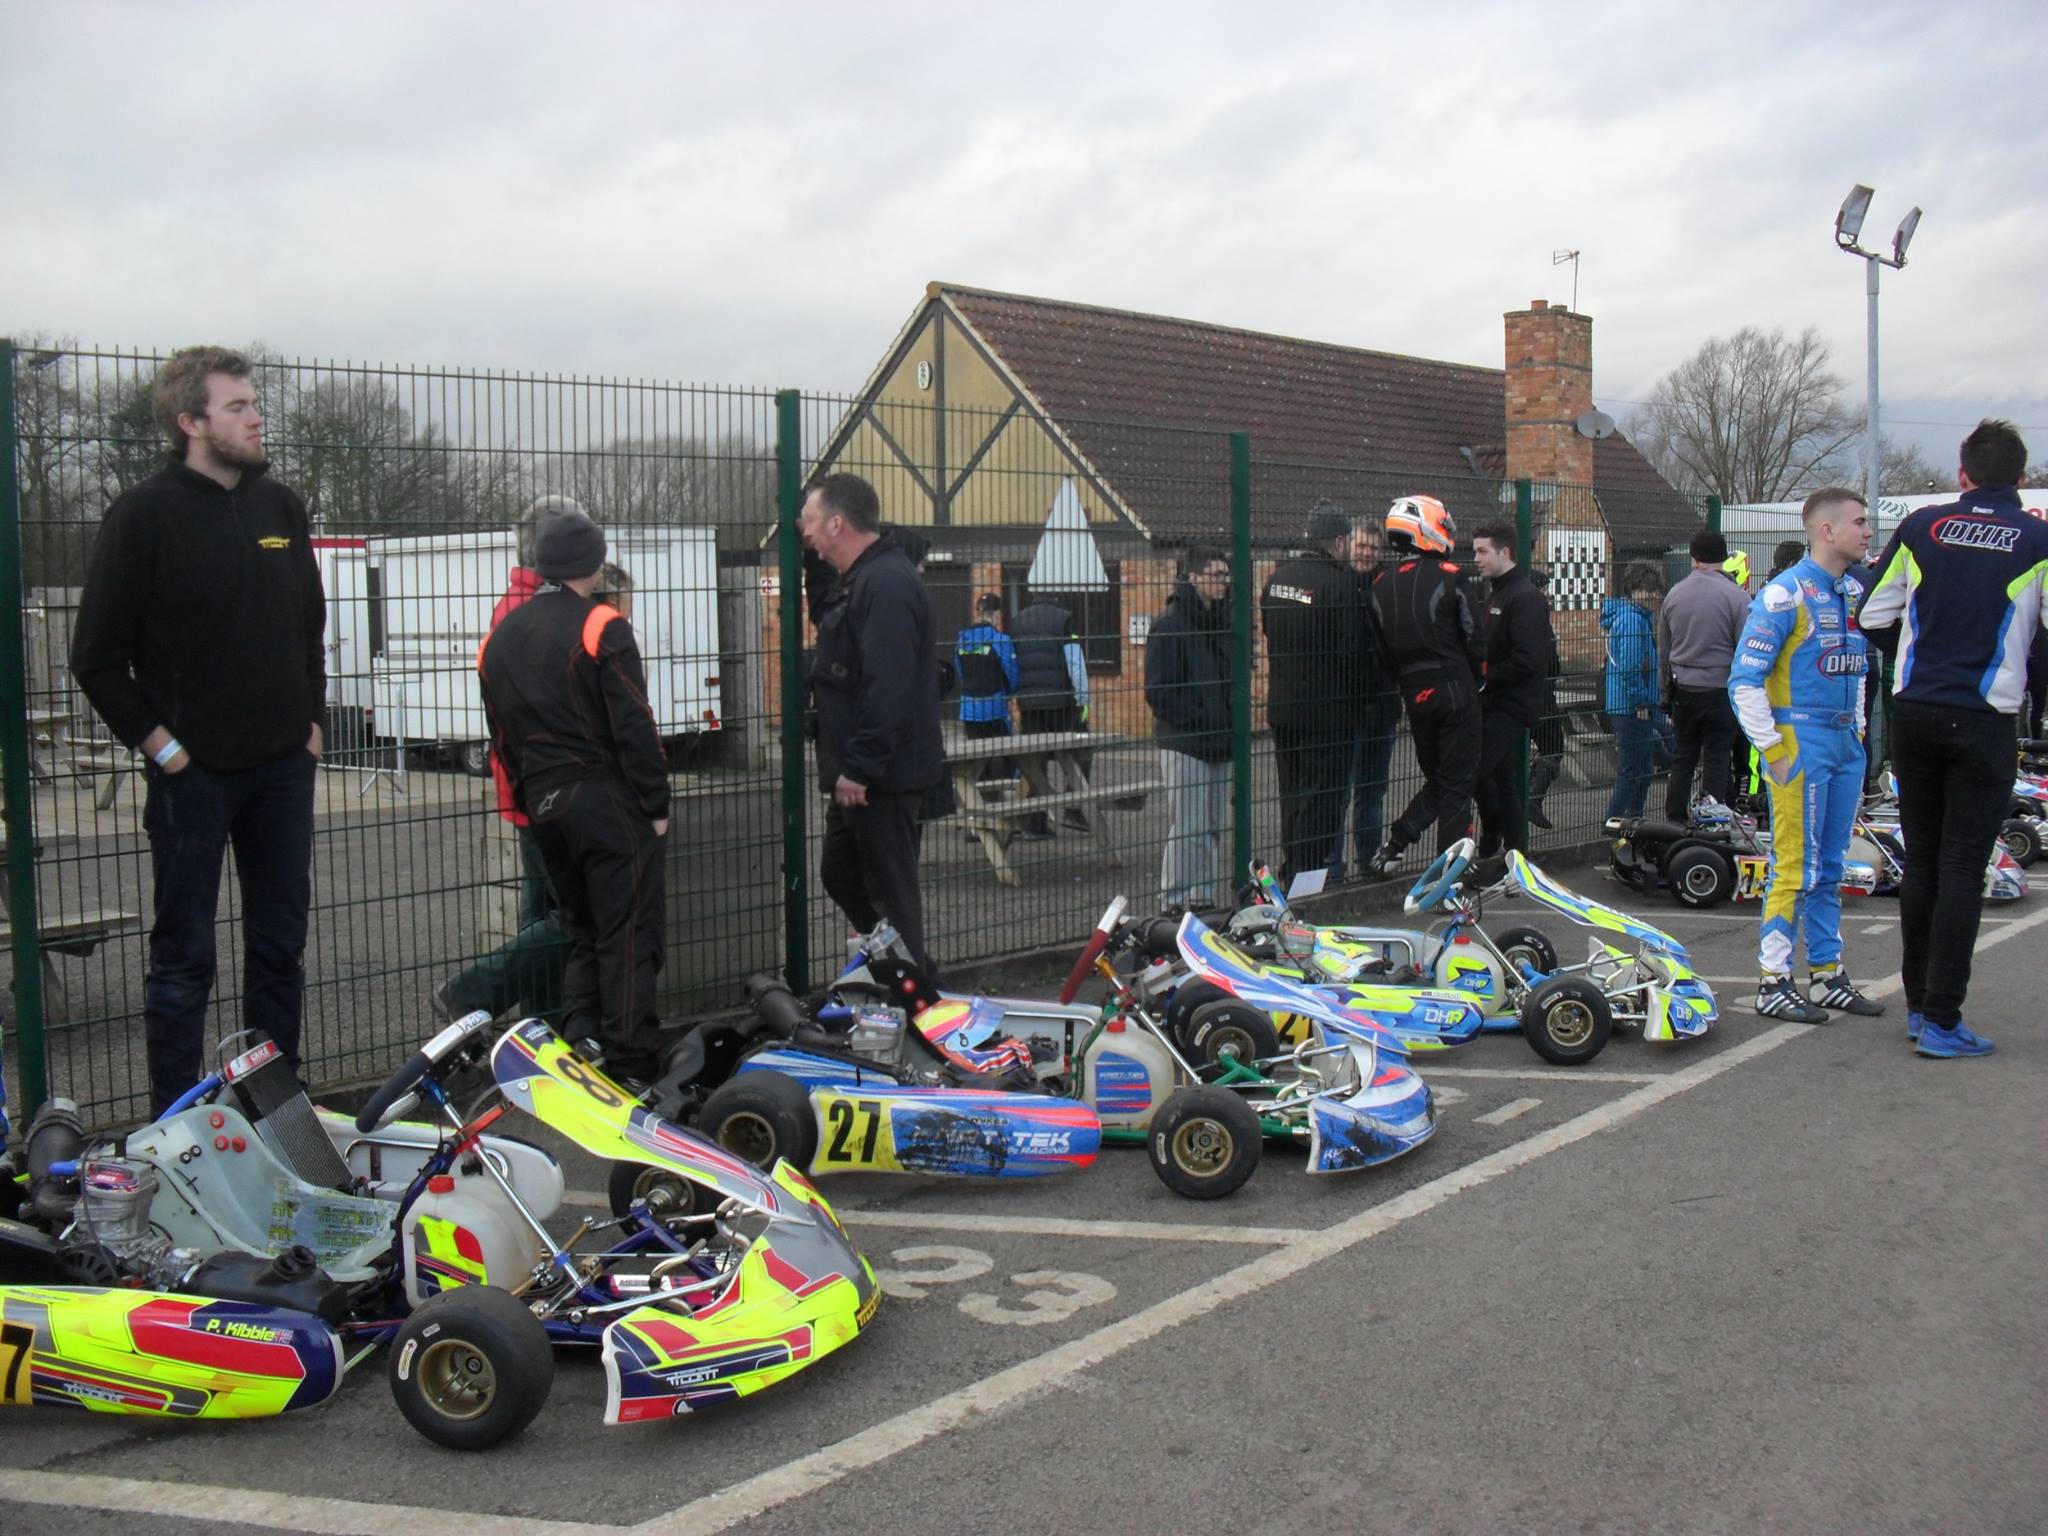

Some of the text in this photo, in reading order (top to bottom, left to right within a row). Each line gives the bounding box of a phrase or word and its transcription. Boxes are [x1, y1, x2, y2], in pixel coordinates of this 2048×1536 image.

[1939, 520, 2021, 549] DHR
[1748, 639, 1773, 652] DHR
[1826, 653, 1862, 673] DHR
[1424, 1007, 1463, 1025] DHR
[828, 1099, 881, 1163] 27
[1020, 1146, 1071, 1155] RACING
[873, 1244, 1118, 1325] 23
[206, 1318, 275, 1341] P. Kibble
[0, 1323, 34, 1400] 7
[666, 1368, 719, 1387] TILLETT
